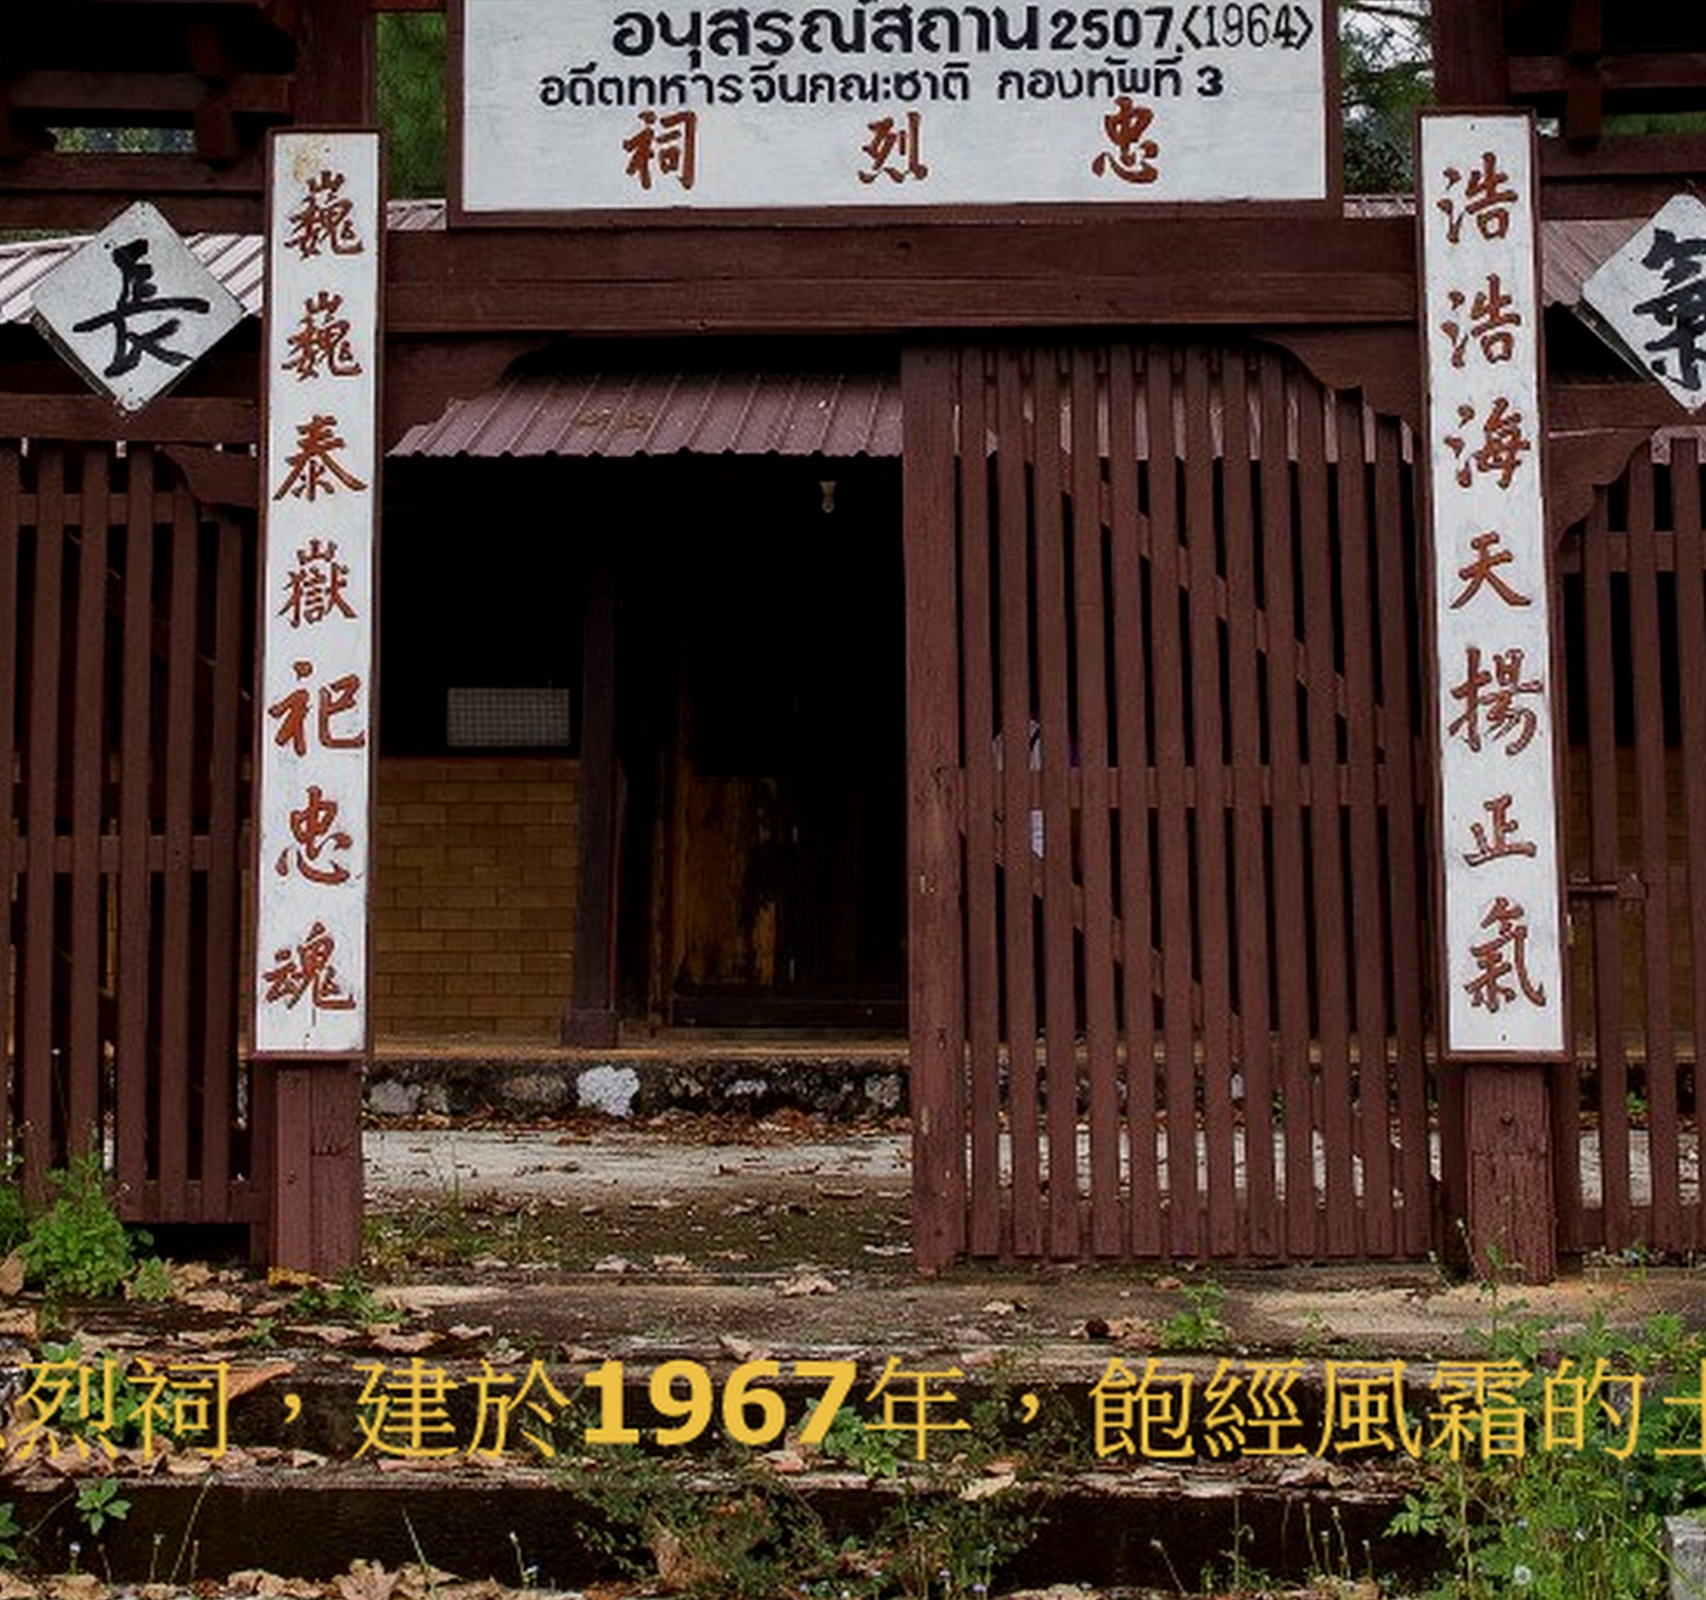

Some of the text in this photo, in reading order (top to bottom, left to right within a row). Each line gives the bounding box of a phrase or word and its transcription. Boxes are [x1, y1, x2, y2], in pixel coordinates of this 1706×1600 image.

[1196, 65, 1224, 98] 3
[1436, 150, 1546, 1012] 浩浩海天揚正氣
